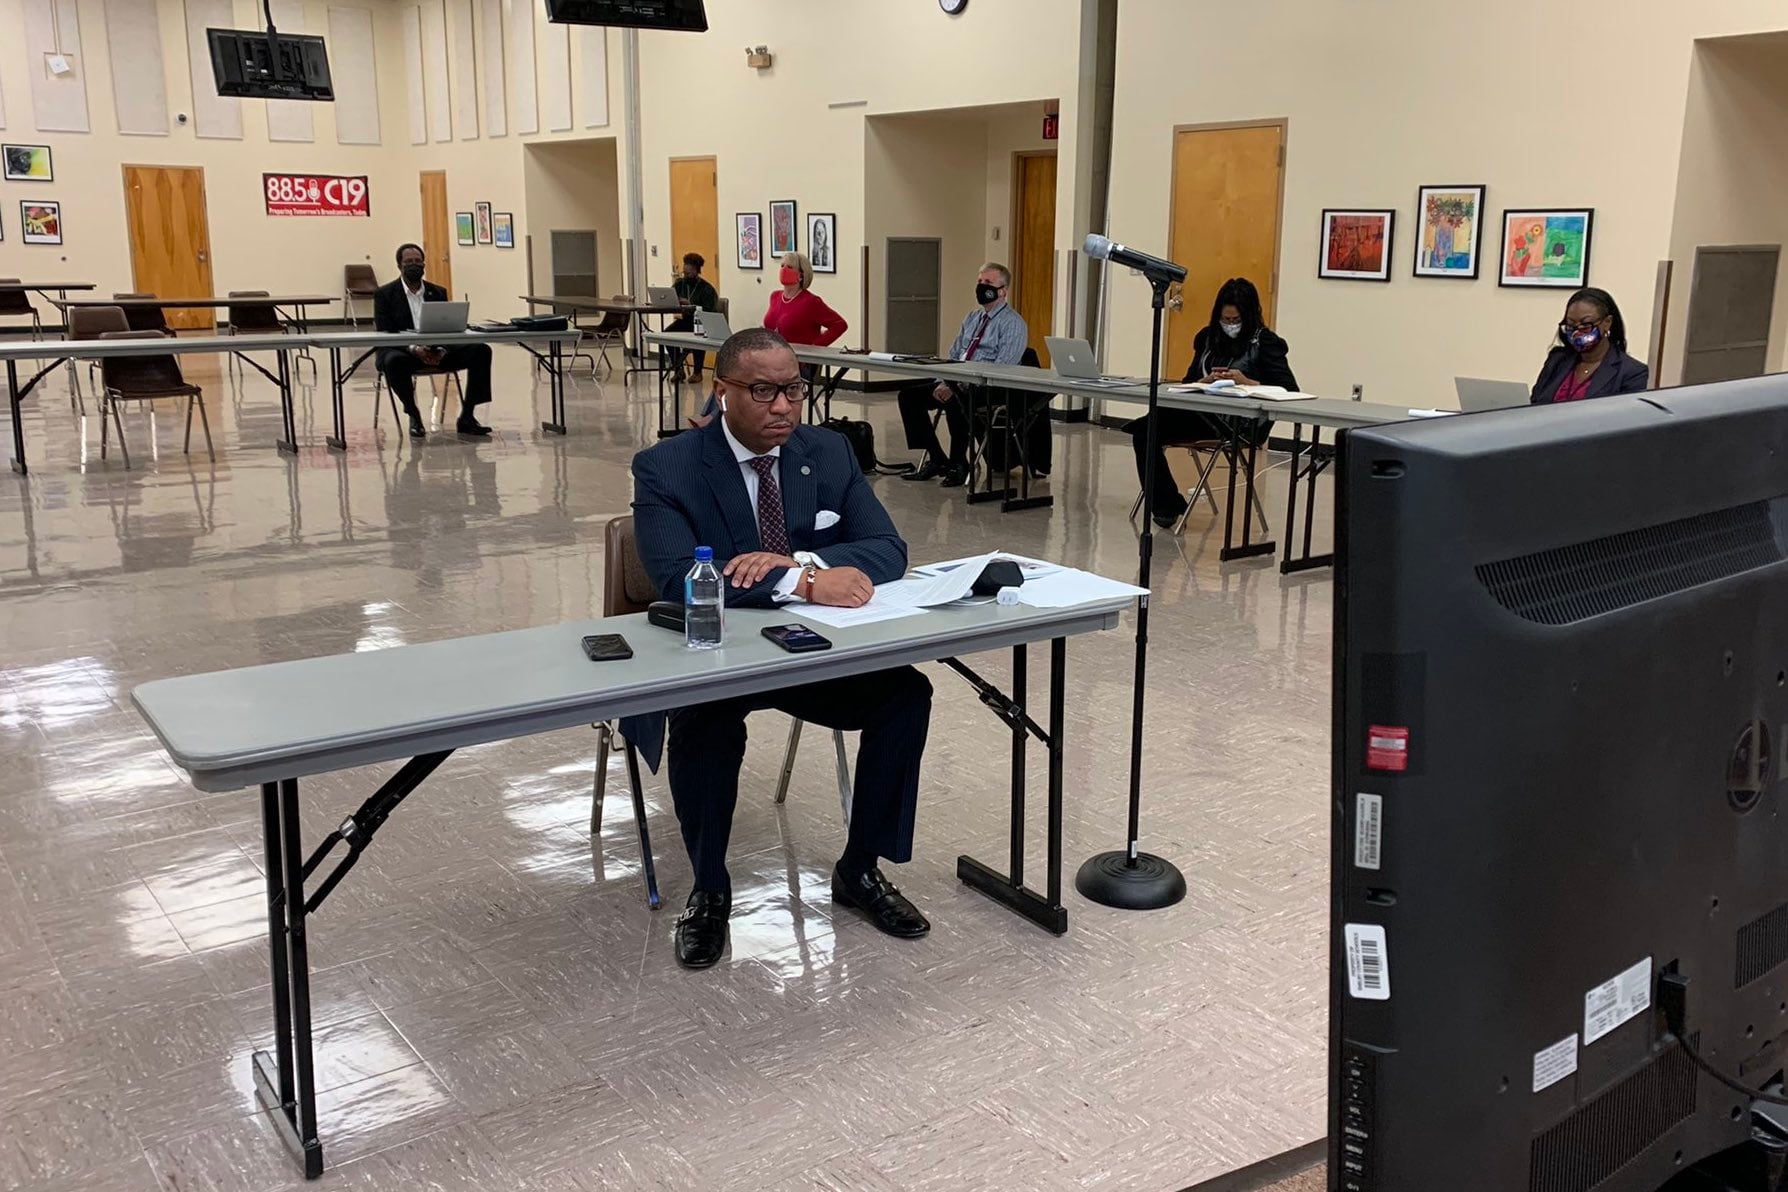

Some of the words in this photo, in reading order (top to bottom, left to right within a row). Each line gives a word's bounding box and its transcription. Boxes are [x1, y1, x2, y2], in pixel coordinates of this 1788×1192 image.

[1046, 119, 1057, 137] EX
[268, 177, 307, 202] 88.5
[324, 179, 366, 206] C19
[269, 208, 293, 217] Preparing
